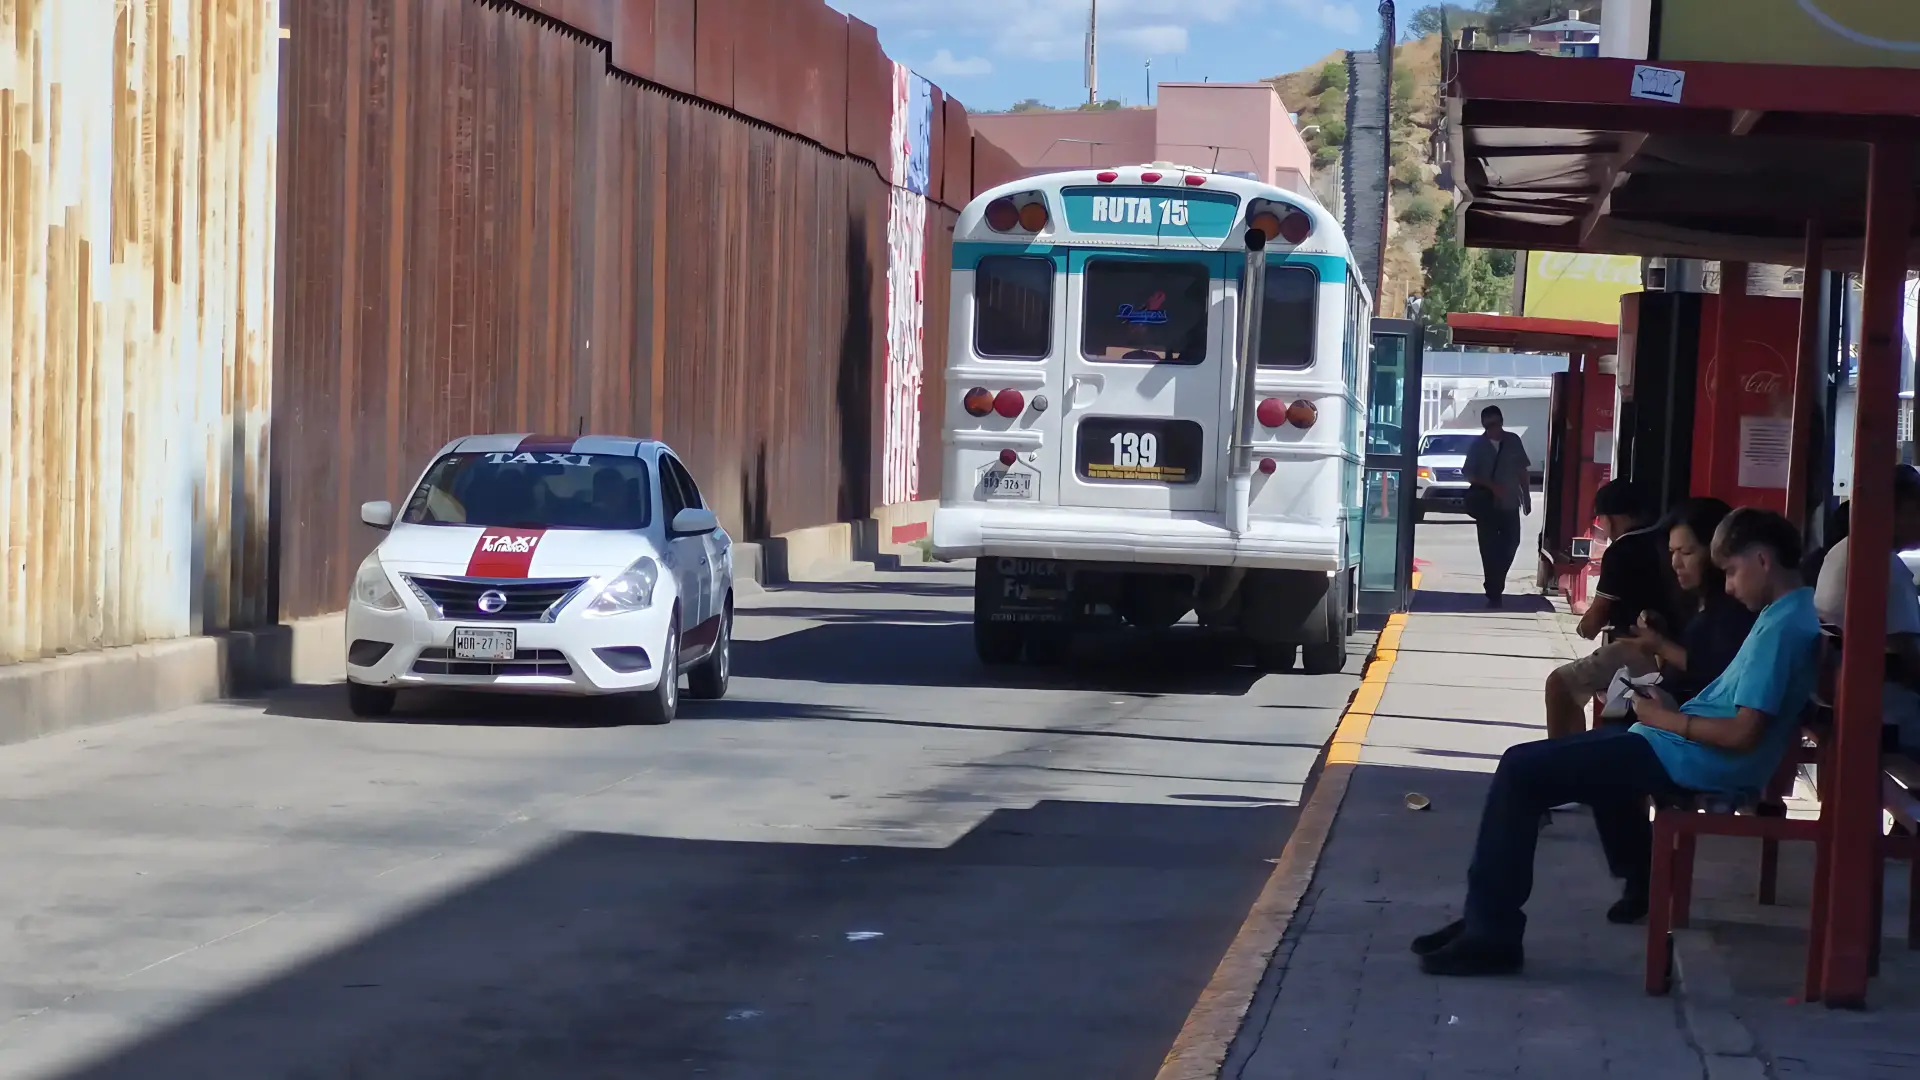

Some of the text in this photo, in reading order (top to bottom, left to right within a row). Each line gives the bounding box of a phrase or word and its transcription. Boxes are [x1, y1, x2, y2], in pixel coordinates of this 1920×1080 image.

[1092, 196, 1189, 226] RUTA 15
[484, 452, 594, 467] TAXI
[1110, 432, 1158, 468] 139
[481, 535, 539, 552] TAXI
